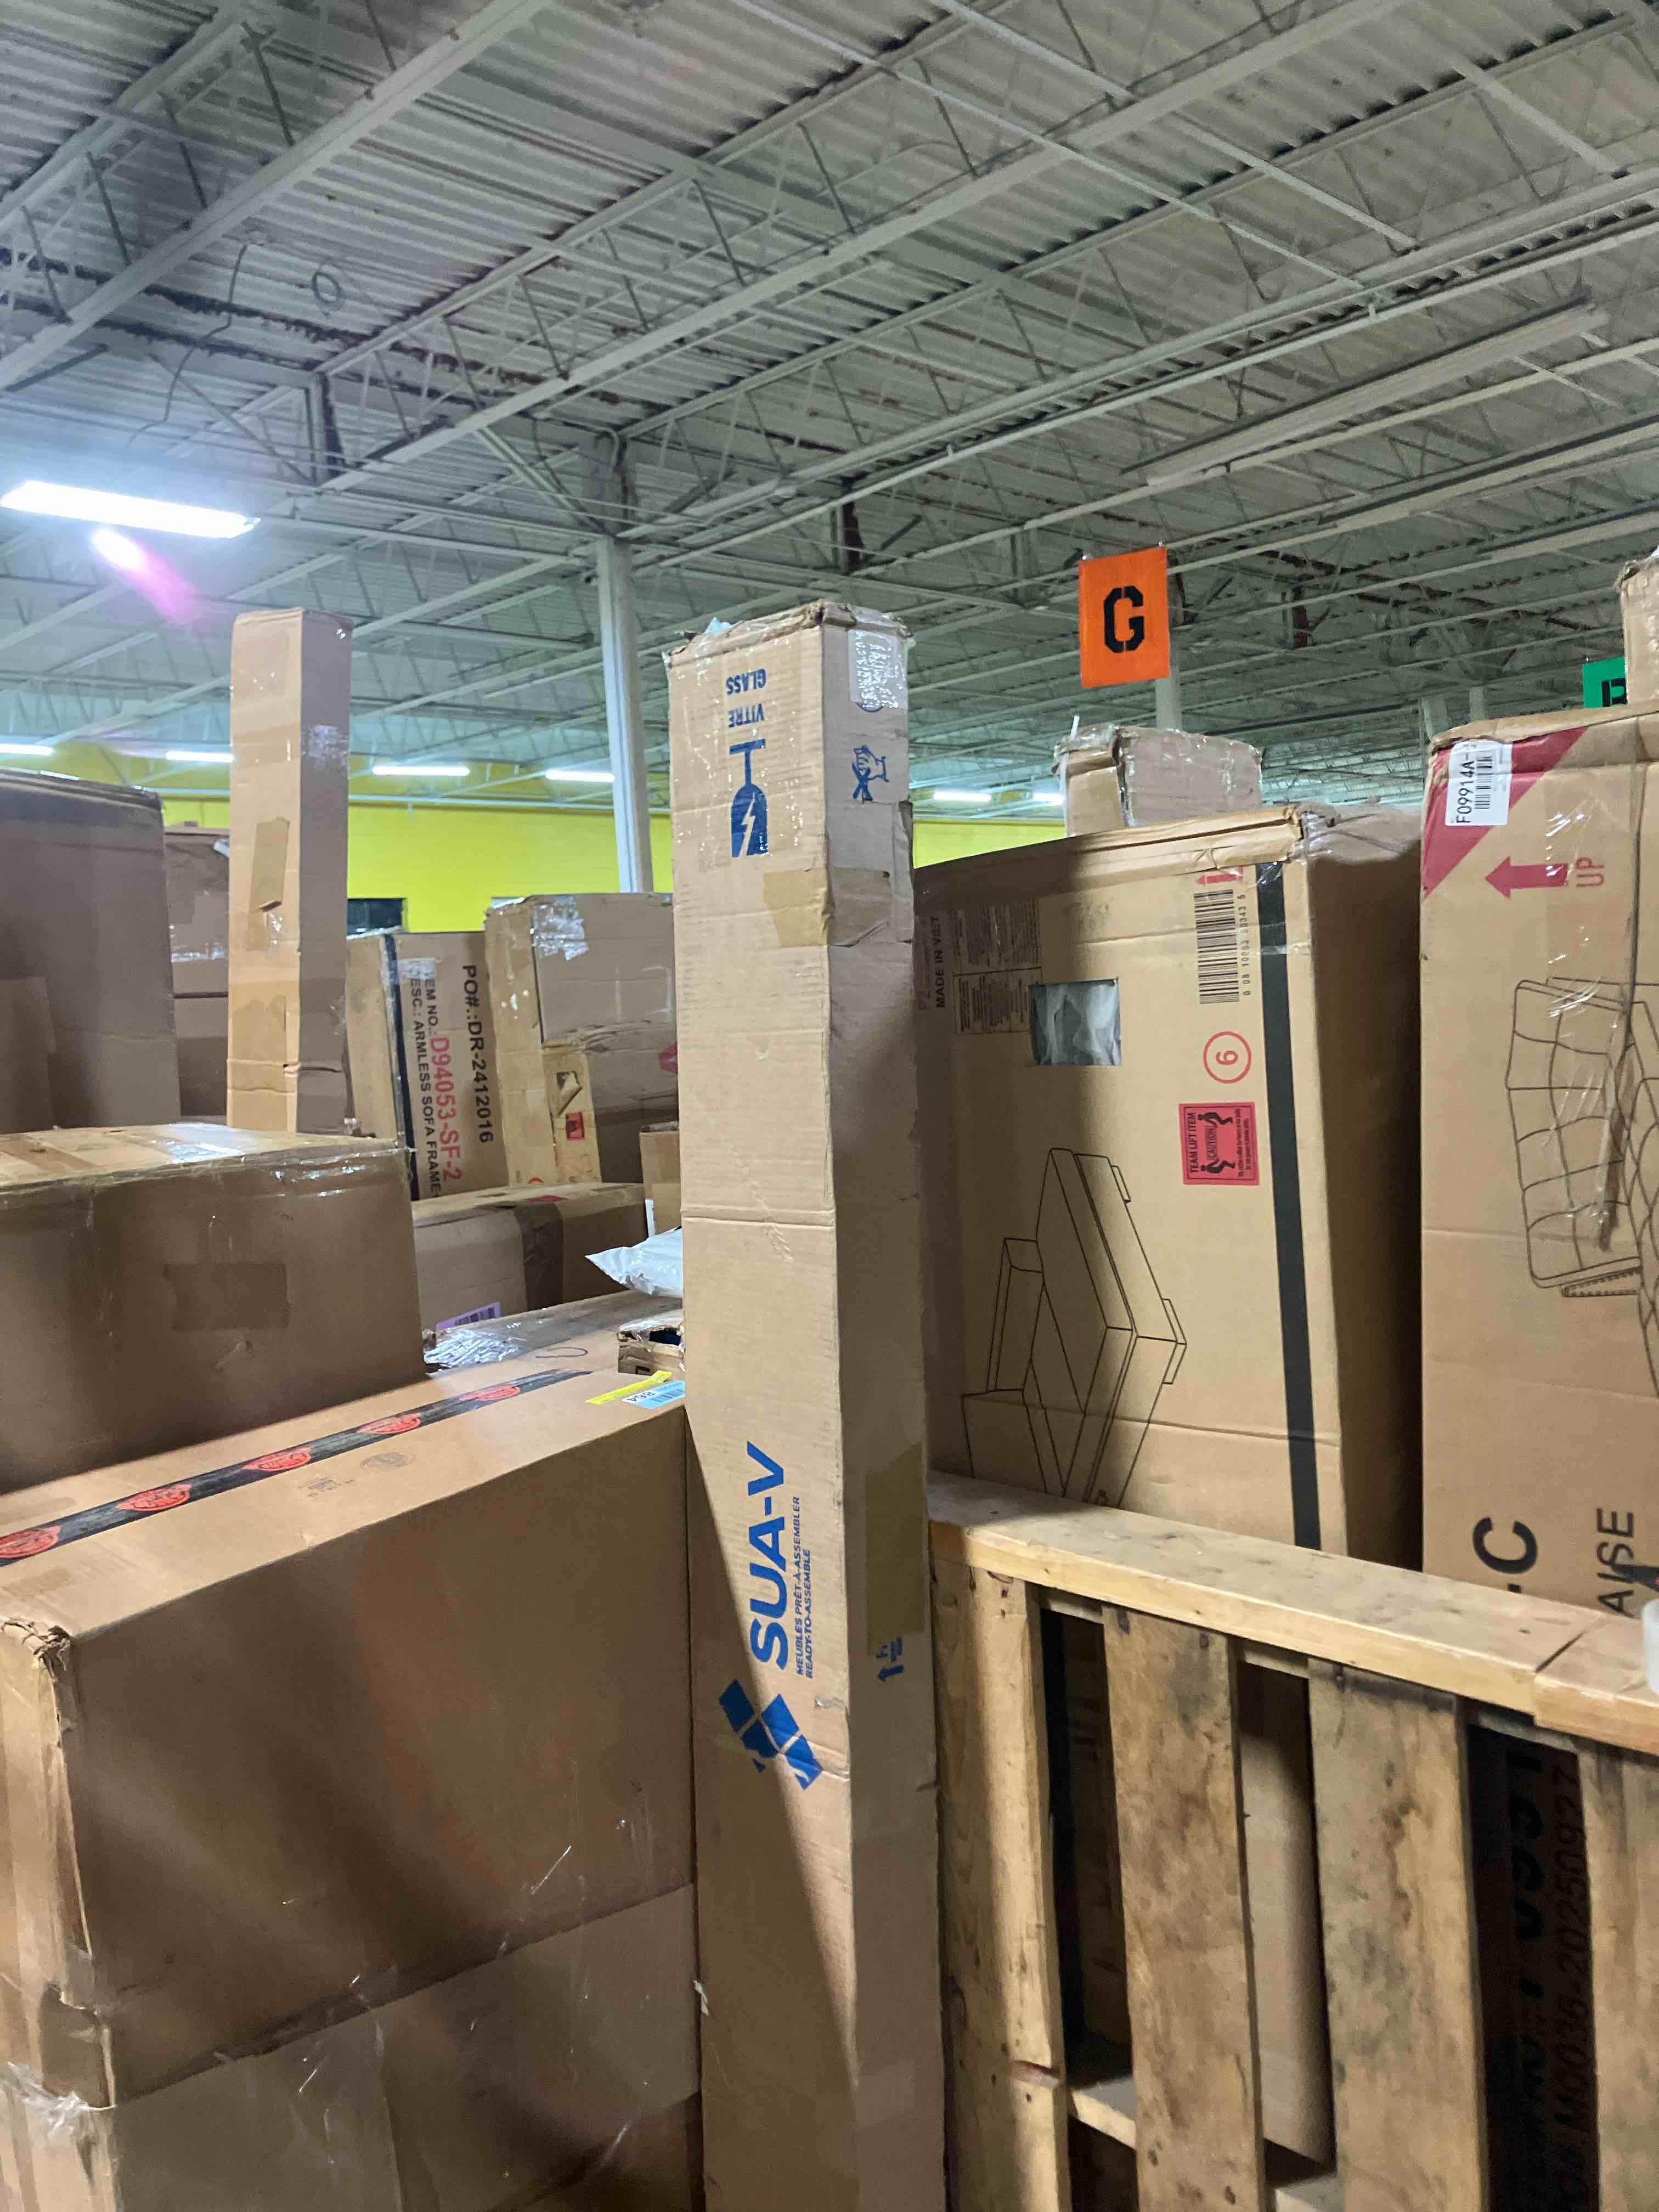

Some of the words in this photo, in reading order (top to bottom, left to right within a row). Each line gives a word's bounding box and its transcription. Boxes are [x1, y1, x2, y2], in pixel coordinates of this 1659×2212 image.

[1104, 585, 1145, 653] G
[725, 668, 767, 695] GLASS
[728, 702, 764, 729] VITRE
[1576, 856, 1604, 888] UP
[933, 950, 943, 963] IN
[935, 968, 946, 1008] MADE
[414, 1020, 431, 1091] ARMLESS
[421, 1093, 435, 1136] SOFA
[430, 1037, 461, 1181] D94053-SF-2
[1187, 1112, 1196, 1131] ITEM
[1188, 1133, 1198, 1150] LIFT
[1189, 1152, 1199, 1173] TEAM
[747, 1440, 789, 1671] SUA-V
[792, 1496, 802, 1616] PRÊT-À-ASSEMBLER
[803, 1549, 812, 1679] READY-TO-ASSEMBLE
[794, 1618, 803, 1675] MEUBLES
